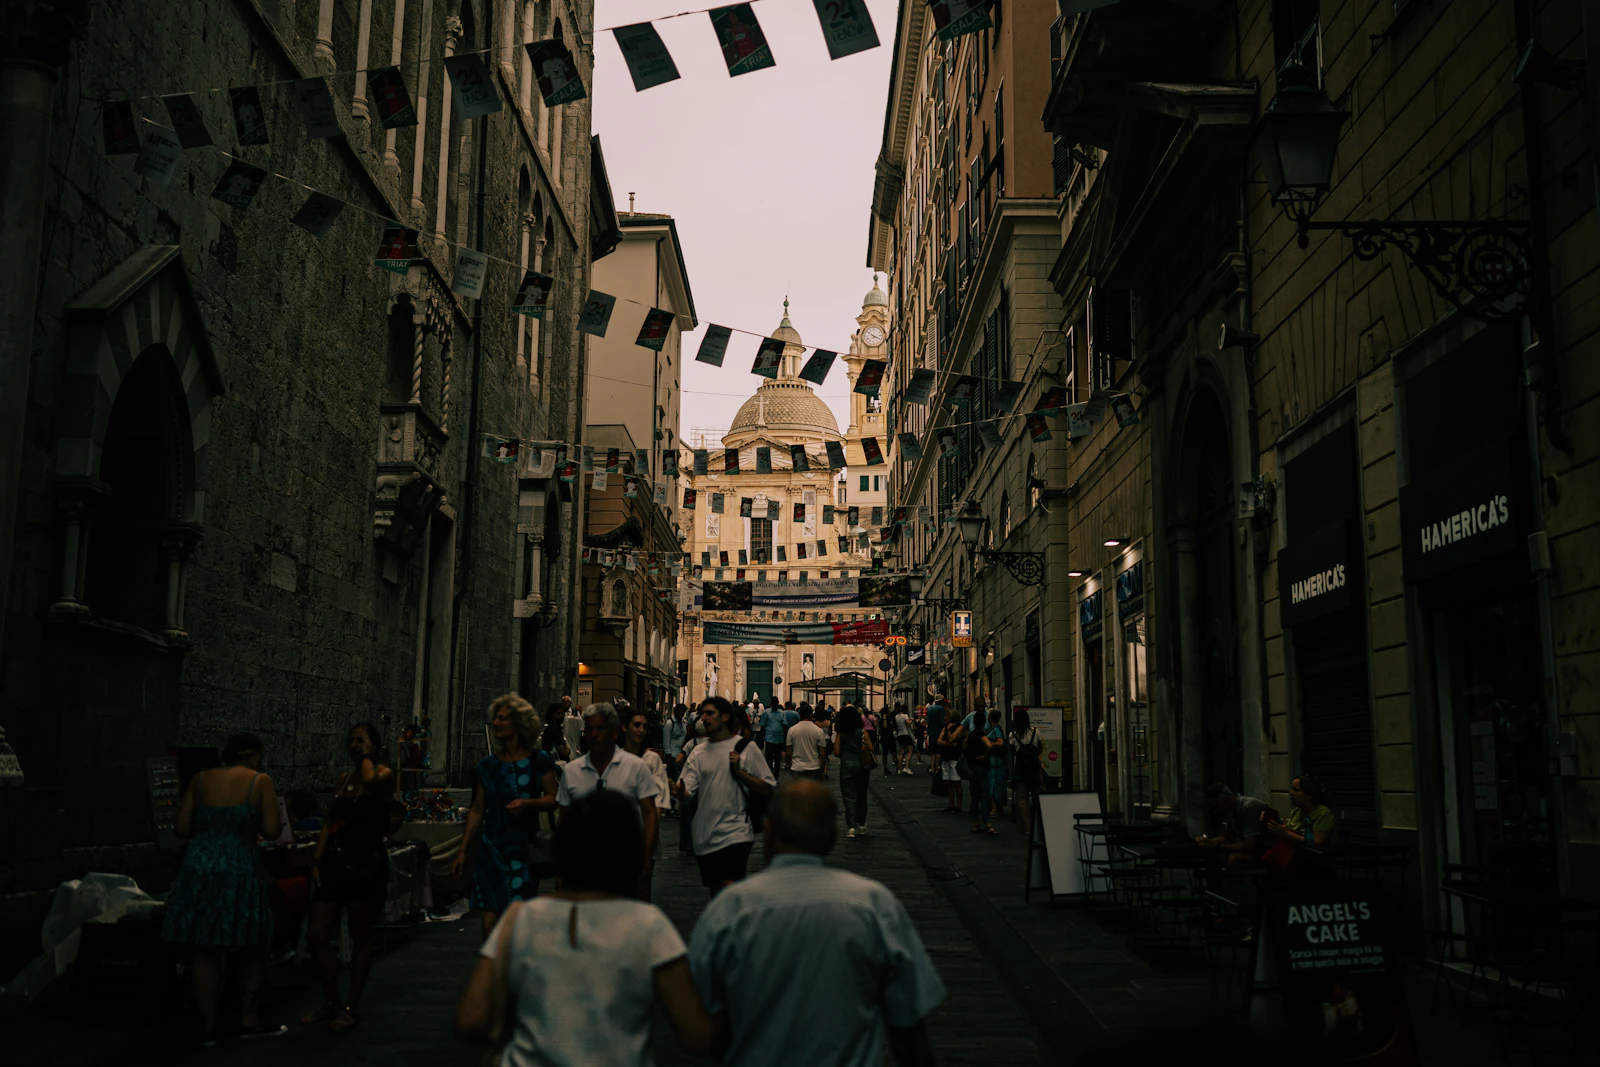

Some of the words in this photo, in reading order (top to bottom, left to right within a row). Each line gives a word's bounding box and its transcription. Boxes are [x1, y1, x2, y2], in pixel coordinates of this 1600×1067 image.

[951, 5, 988, 36] GALAN
[742, 48, 770, 69] TRIAY
[553, 80, 581, 105] GALAN
[386, 260, 408, 268] TRIAY
[1420, 495, 1509, 553] HAMERICA'S
[1291, 564, 1346, 604] HAMERICA'S
[1288, 901, 1371, 924] ANGEL'S
[1305, 923, 1360, 943] CAKE
